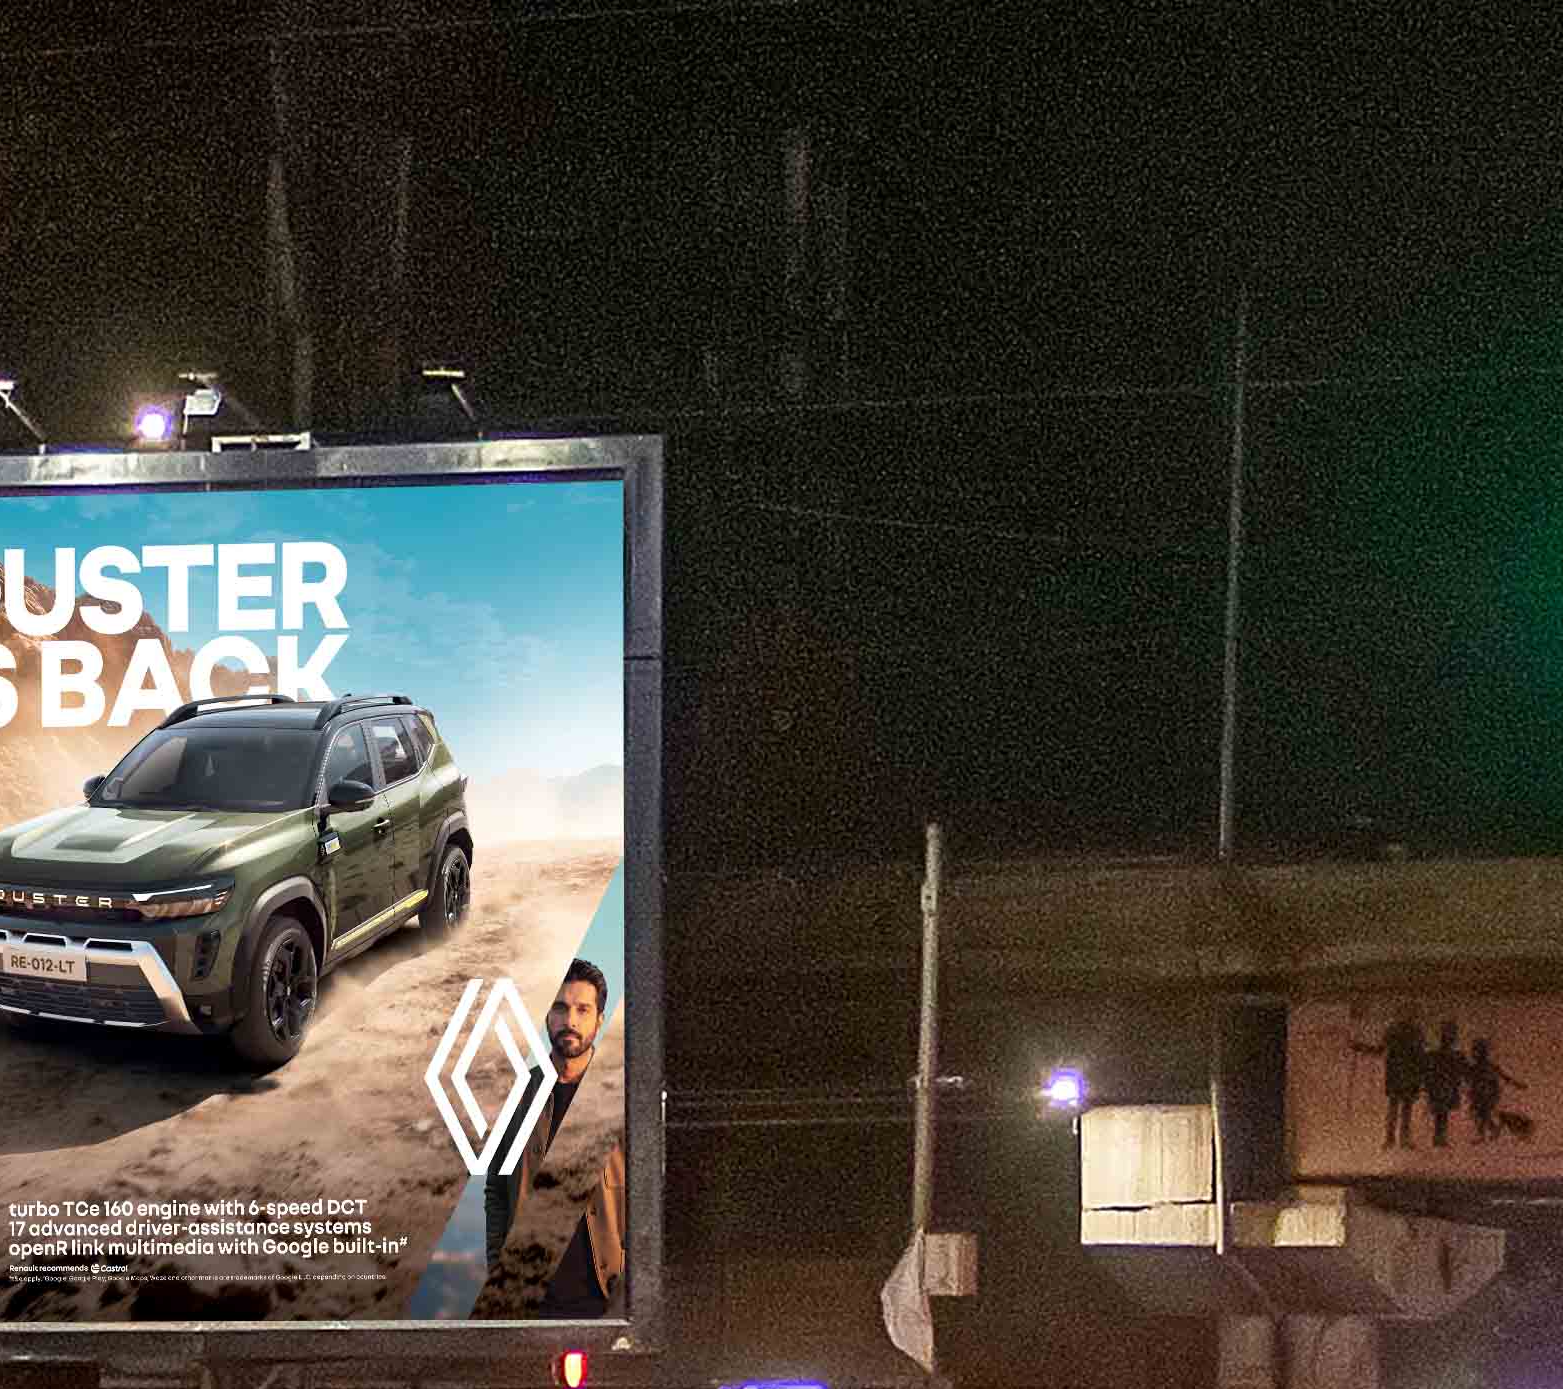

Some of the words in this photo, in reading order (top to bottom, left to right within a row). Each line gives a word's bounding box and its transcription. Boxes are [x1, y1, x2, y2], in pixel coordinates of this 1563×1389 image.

[40, 633, 349, 729] BACK
[9, 953, 77, 975] RE-012-LT
[8, 1200, 60, 1217] turbo
[63, 1200, 101, 1217] TCe
[104, 1200, 134, 1217] 160
[137, 1199, 201, 1221] engine
[203, 1199, 245, 1216] with
[248, 1198, 323, 1219] 6-speed
[327, 1199, 368, 1215] DCT
[8, 1221, 25, 1237] 17
[28, 1220, 122, 1237] advanced
[125, 1218, 290, 1236] driver-assistance
[293, 1220, 373, 1239] systems
[8, 1240, 68, 1260] openR
[71, 1239, 105, 1256] link
[108, 1239, 214, 1256] multimedia
[217, 1238, 259, 1255] with
[262, 1238, 330, 1258] Google
[8, 1264, 38, 1273] Renault
[39, 1264, 89, 1273] recommends
[100, 1264, 128, 1274] Castrol
